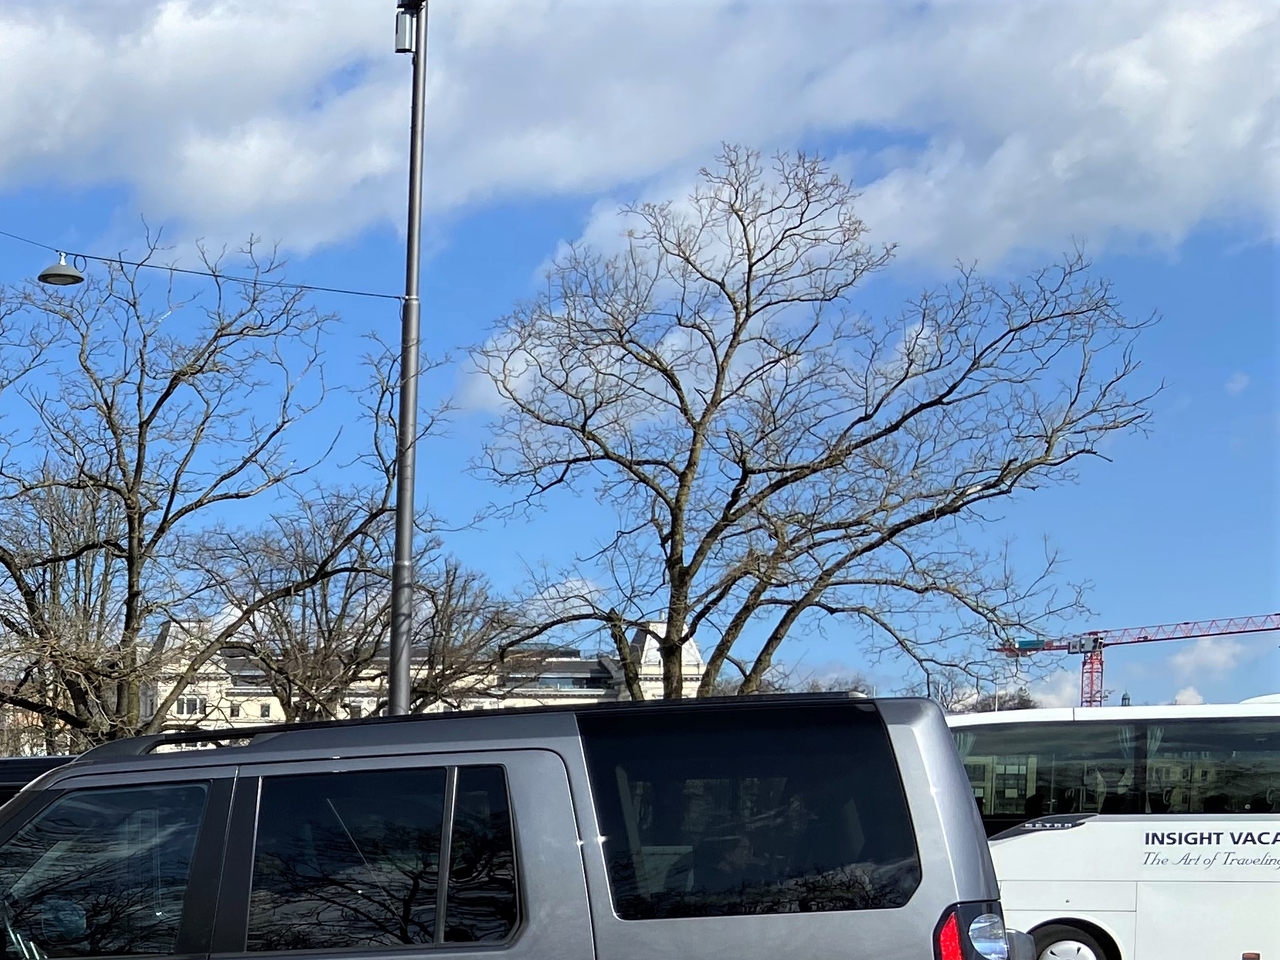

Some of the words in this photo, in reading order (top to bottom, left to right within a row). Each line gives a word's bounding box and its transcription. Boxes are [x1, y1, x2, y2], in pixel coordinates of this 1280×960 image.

[1145, 832, 1224, 845] INSIGHT
[1142, 851, 1169, 866] The
[1172, 851, 1201, 866] Art
[1203, 851, 1221, 870] of
